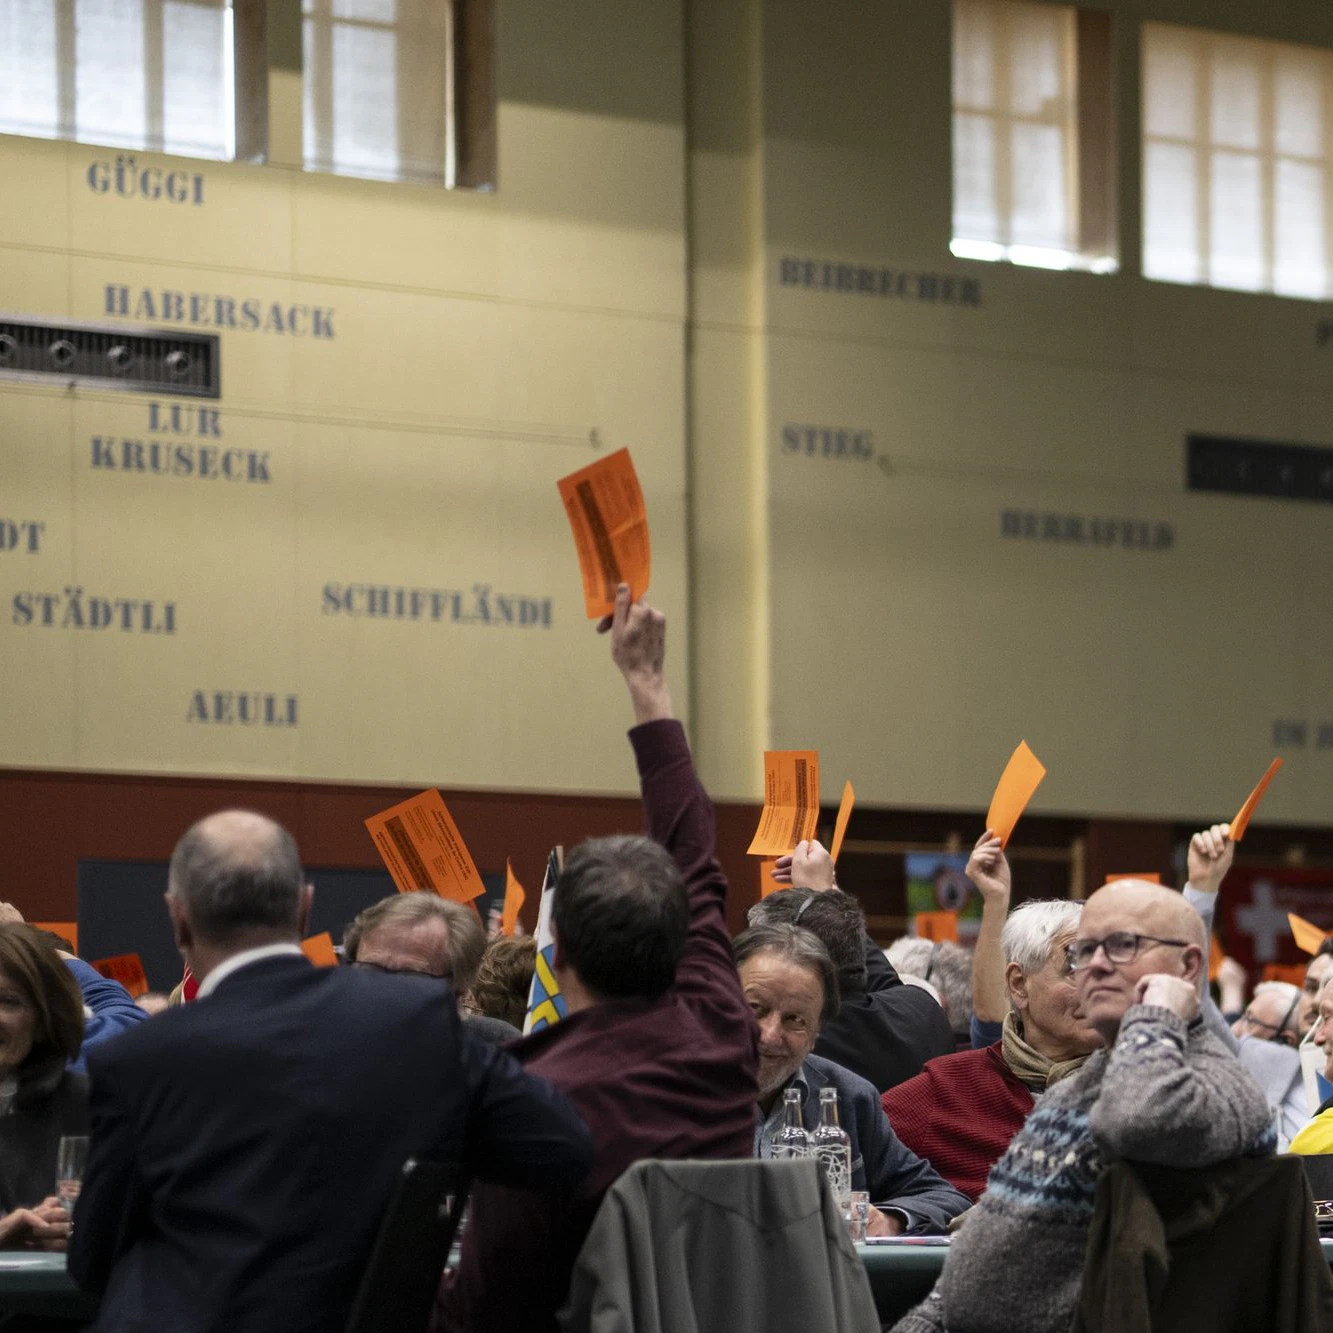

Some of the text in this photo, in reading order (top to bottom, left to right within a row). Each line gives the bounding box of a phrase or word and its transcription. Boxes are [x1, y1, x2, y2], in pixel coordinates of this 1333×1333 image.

[86, 154, 206, 205] GÜGGI
[103, 283, 338, 341] HABERSACK
[147, 402, 223, 438] LUR
[782, 422, 873, 463] STIEG
[91, 436, 272, 484] KRUSECK
[12, 584, 176, 635] STÄDTLI
[321, 580, 555, 631] SCHIFFLÄNDI
[186, 689, 300, 727] AEULI
